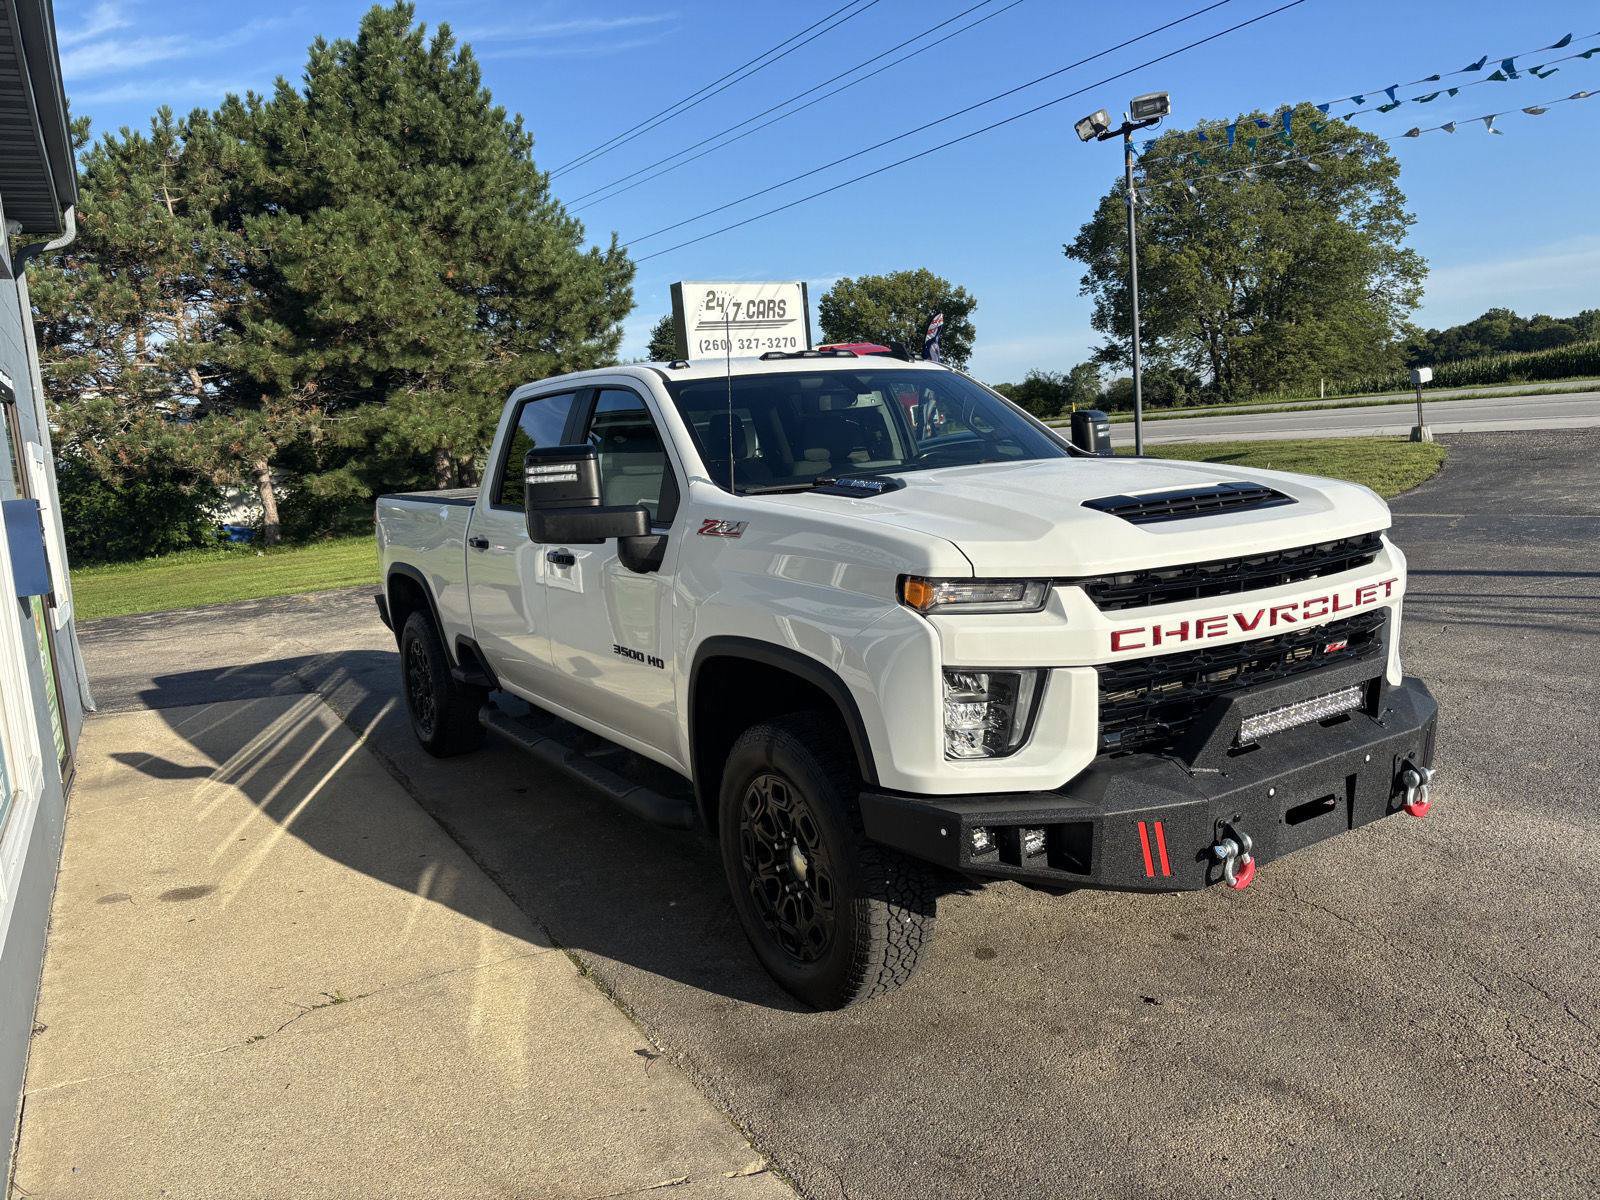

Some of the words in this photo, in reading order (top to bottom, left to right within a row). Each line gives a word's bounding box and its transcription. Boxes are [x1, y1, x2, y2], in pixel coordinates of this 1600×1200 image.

[746, 298, 787, 319] CARS
[738, 336, 797, 350] 327-3270
[1110, 577, 1399, 652] CHEVROLET
[613, 644, 645, 662] 3500
[647, 654, 665, 669] HD
